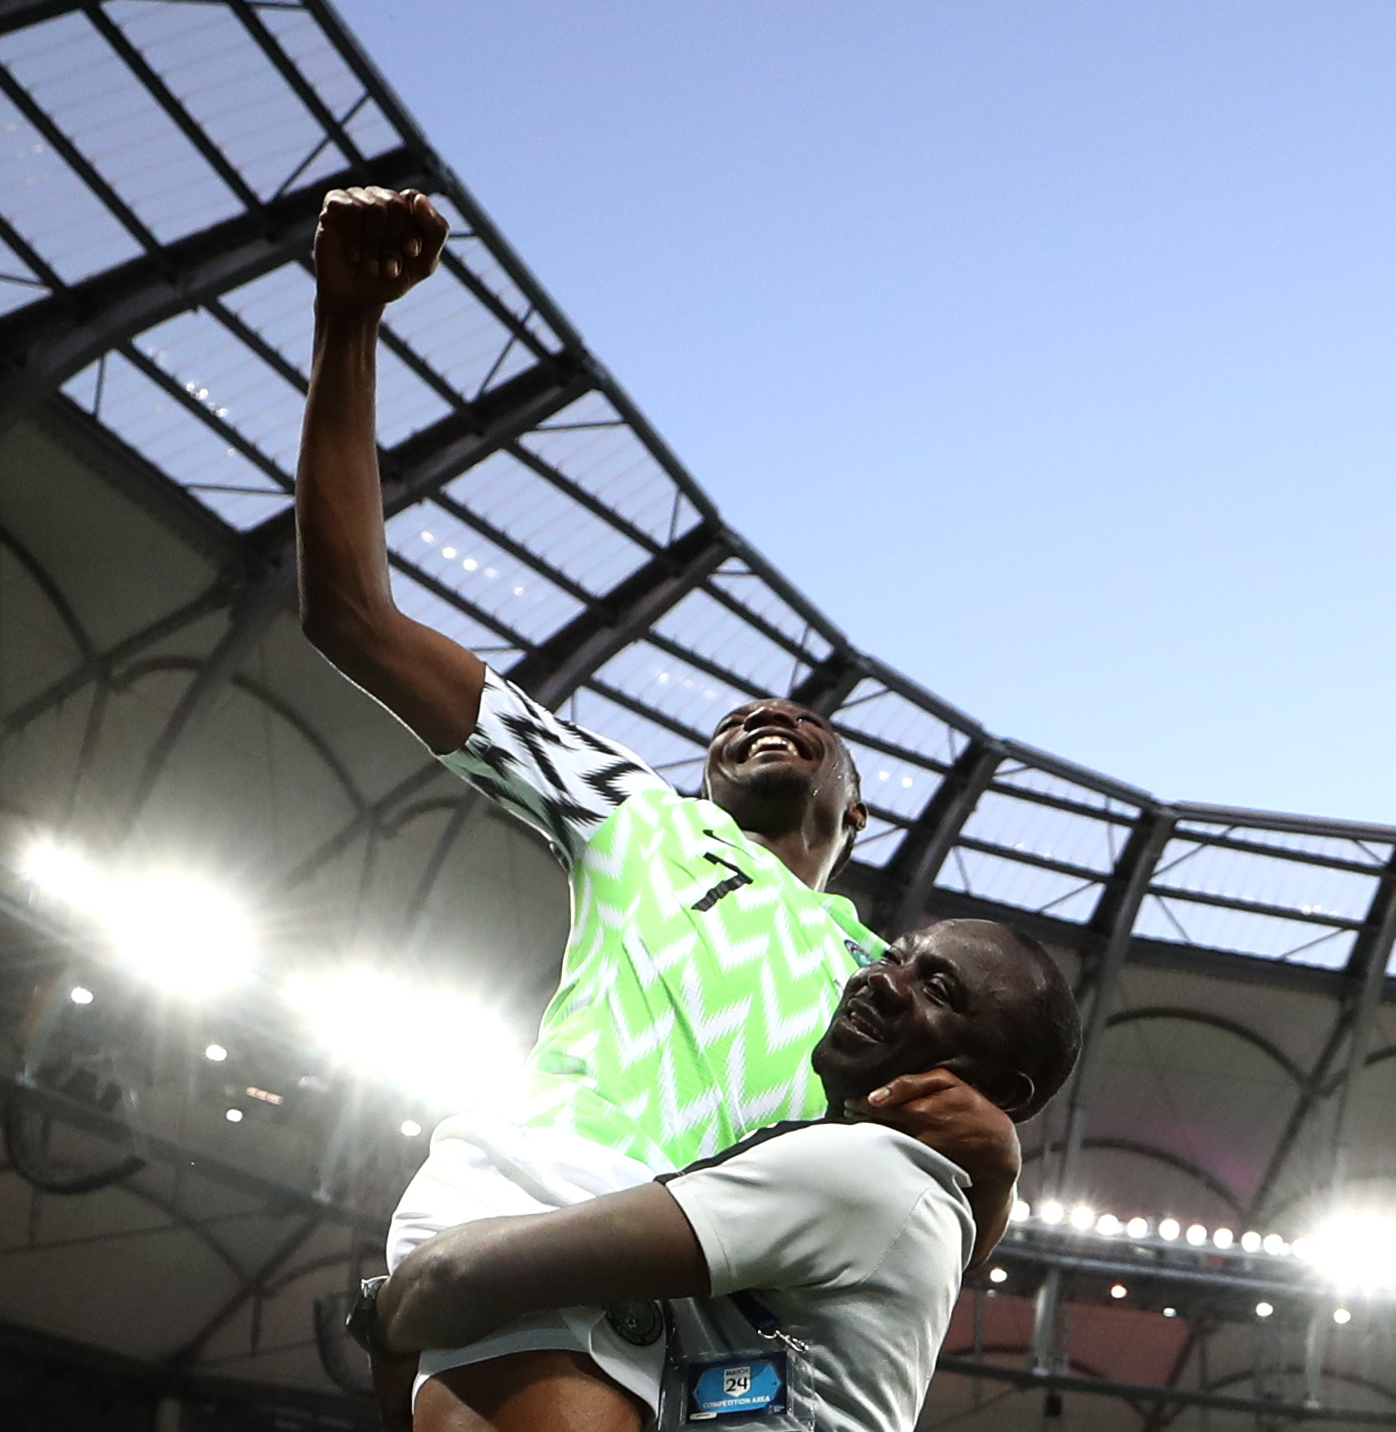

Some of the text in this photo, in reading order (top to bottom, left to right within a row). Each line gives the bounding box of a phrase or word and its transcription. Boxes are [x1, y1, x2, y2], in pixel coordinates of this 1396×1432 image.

[691, 852, 753, 912] 7
[725, 1377, 748, 1392] 24
[702, 1395, 771, 1409] COMPETITION AREA
